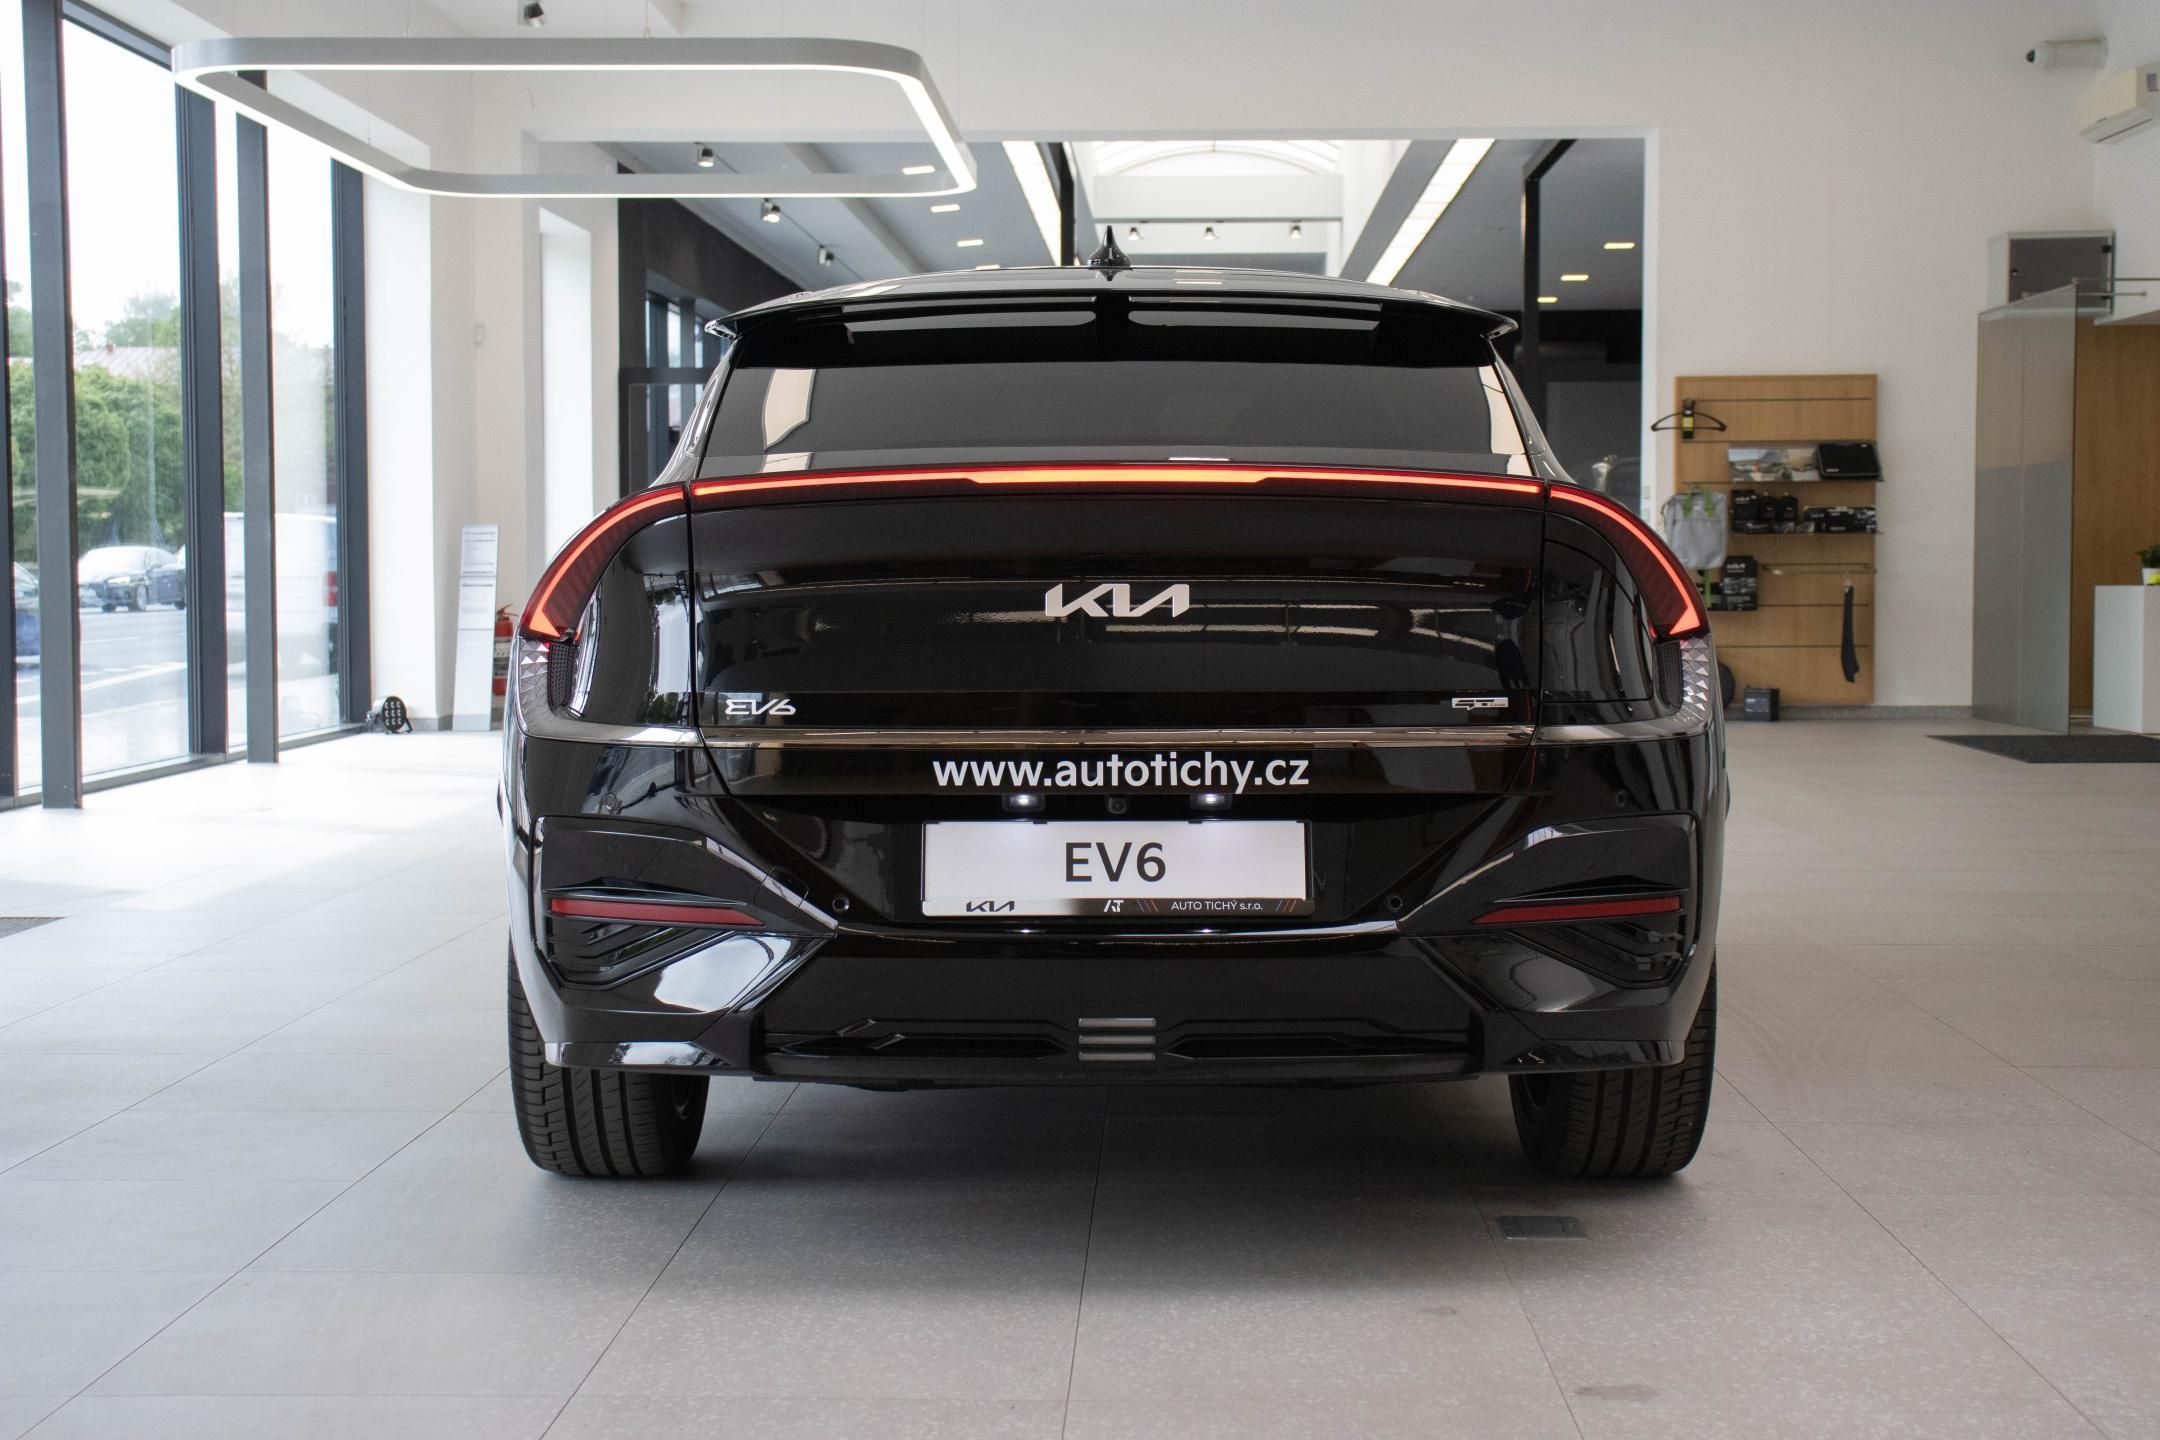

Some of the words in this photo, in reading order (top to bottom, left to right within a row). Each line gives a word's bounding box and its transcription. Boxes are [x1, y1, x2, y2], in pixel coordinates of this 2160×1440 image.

[1045, 583, 1190, 618] KIA
[725, 698, 796, 715] EV6
[933, 751, 1309, 793] www.autotichy.cz
[1065, 841, 1166, 883] EV6
[966, 900, 1015, 912] KIA
[1171, 901, 1202, 911] AUTO
[1205, 899, 1237, 911] TICHÝ
[1239, 902, 1263, 911] s.r.o.
